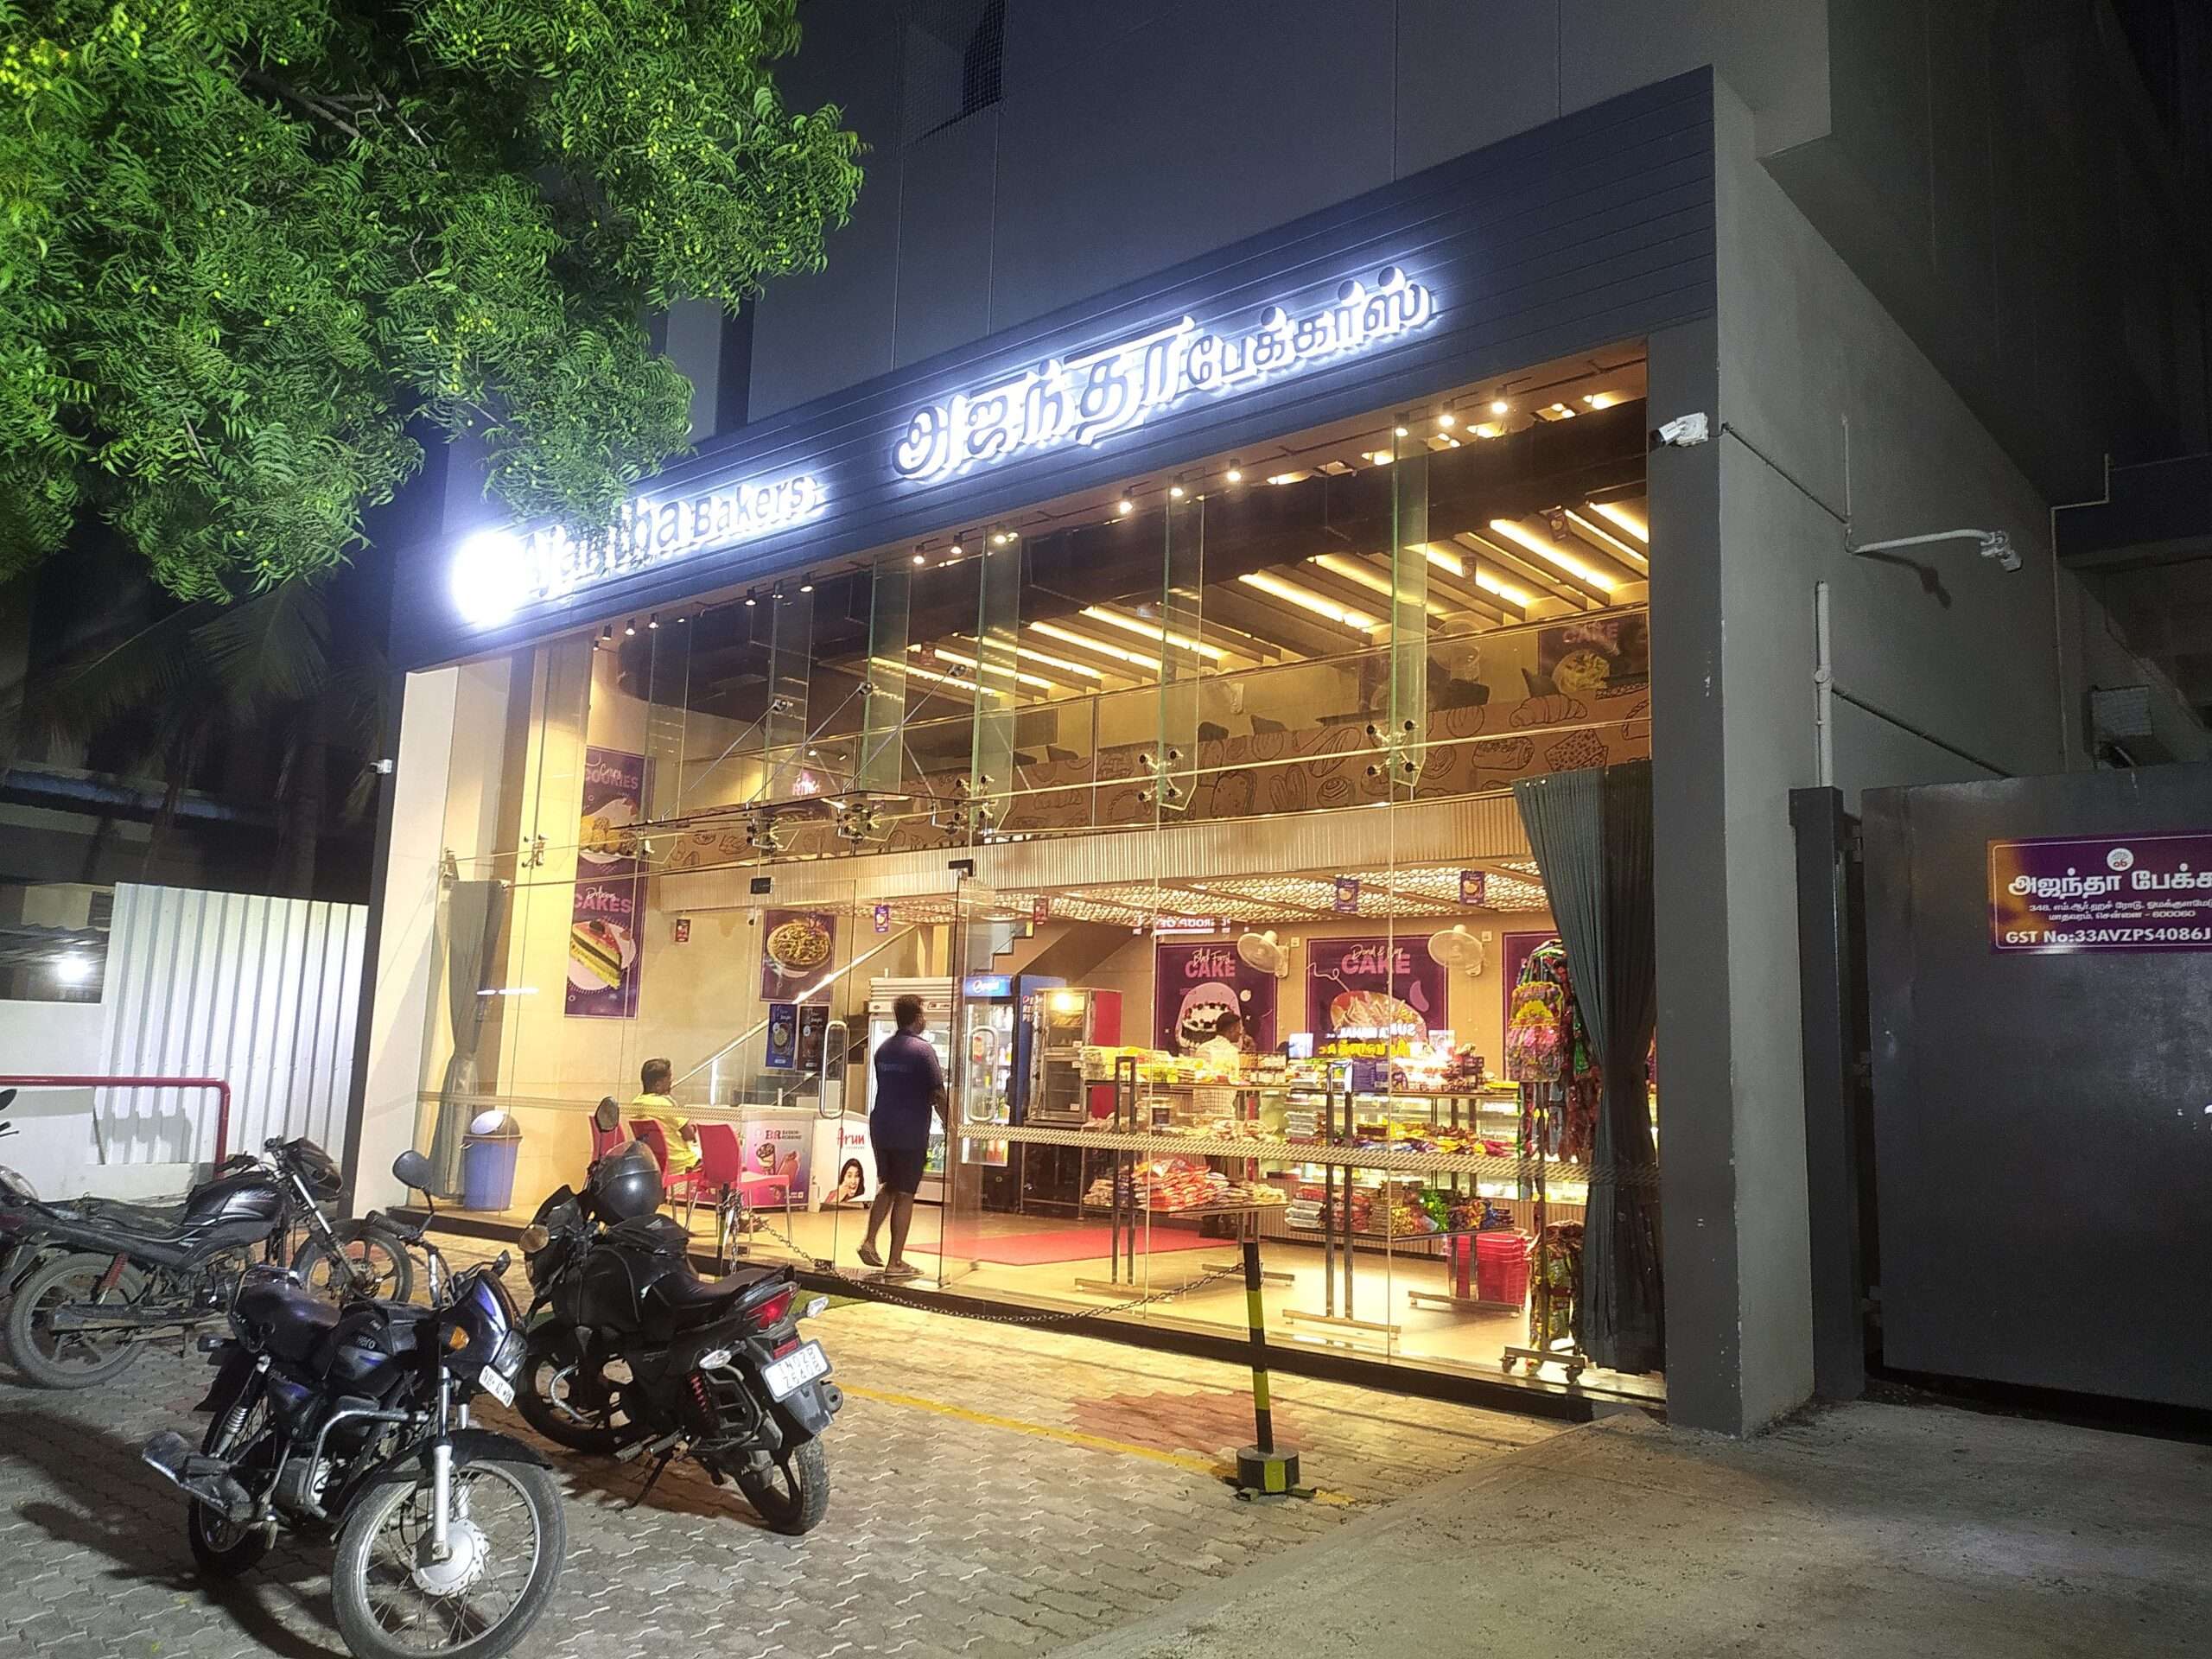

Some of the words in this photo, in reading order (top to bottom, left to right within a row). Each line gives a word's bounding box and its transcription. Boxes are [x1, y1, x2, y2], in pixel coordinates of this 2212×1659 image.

[893, 316, 1195, 477] அஜந்தா
[1186, 266, 1431, 387] பேக்கர்ஸ்
[693, 475, 817, 537] Bakers
[2008, 868, 2122, 899] அஜந்தா
[2005, 931, 2038, 944] GST
[1185, 959, 1236, 978] CAKE
[1341, 954, 1411, 975] CAKE
